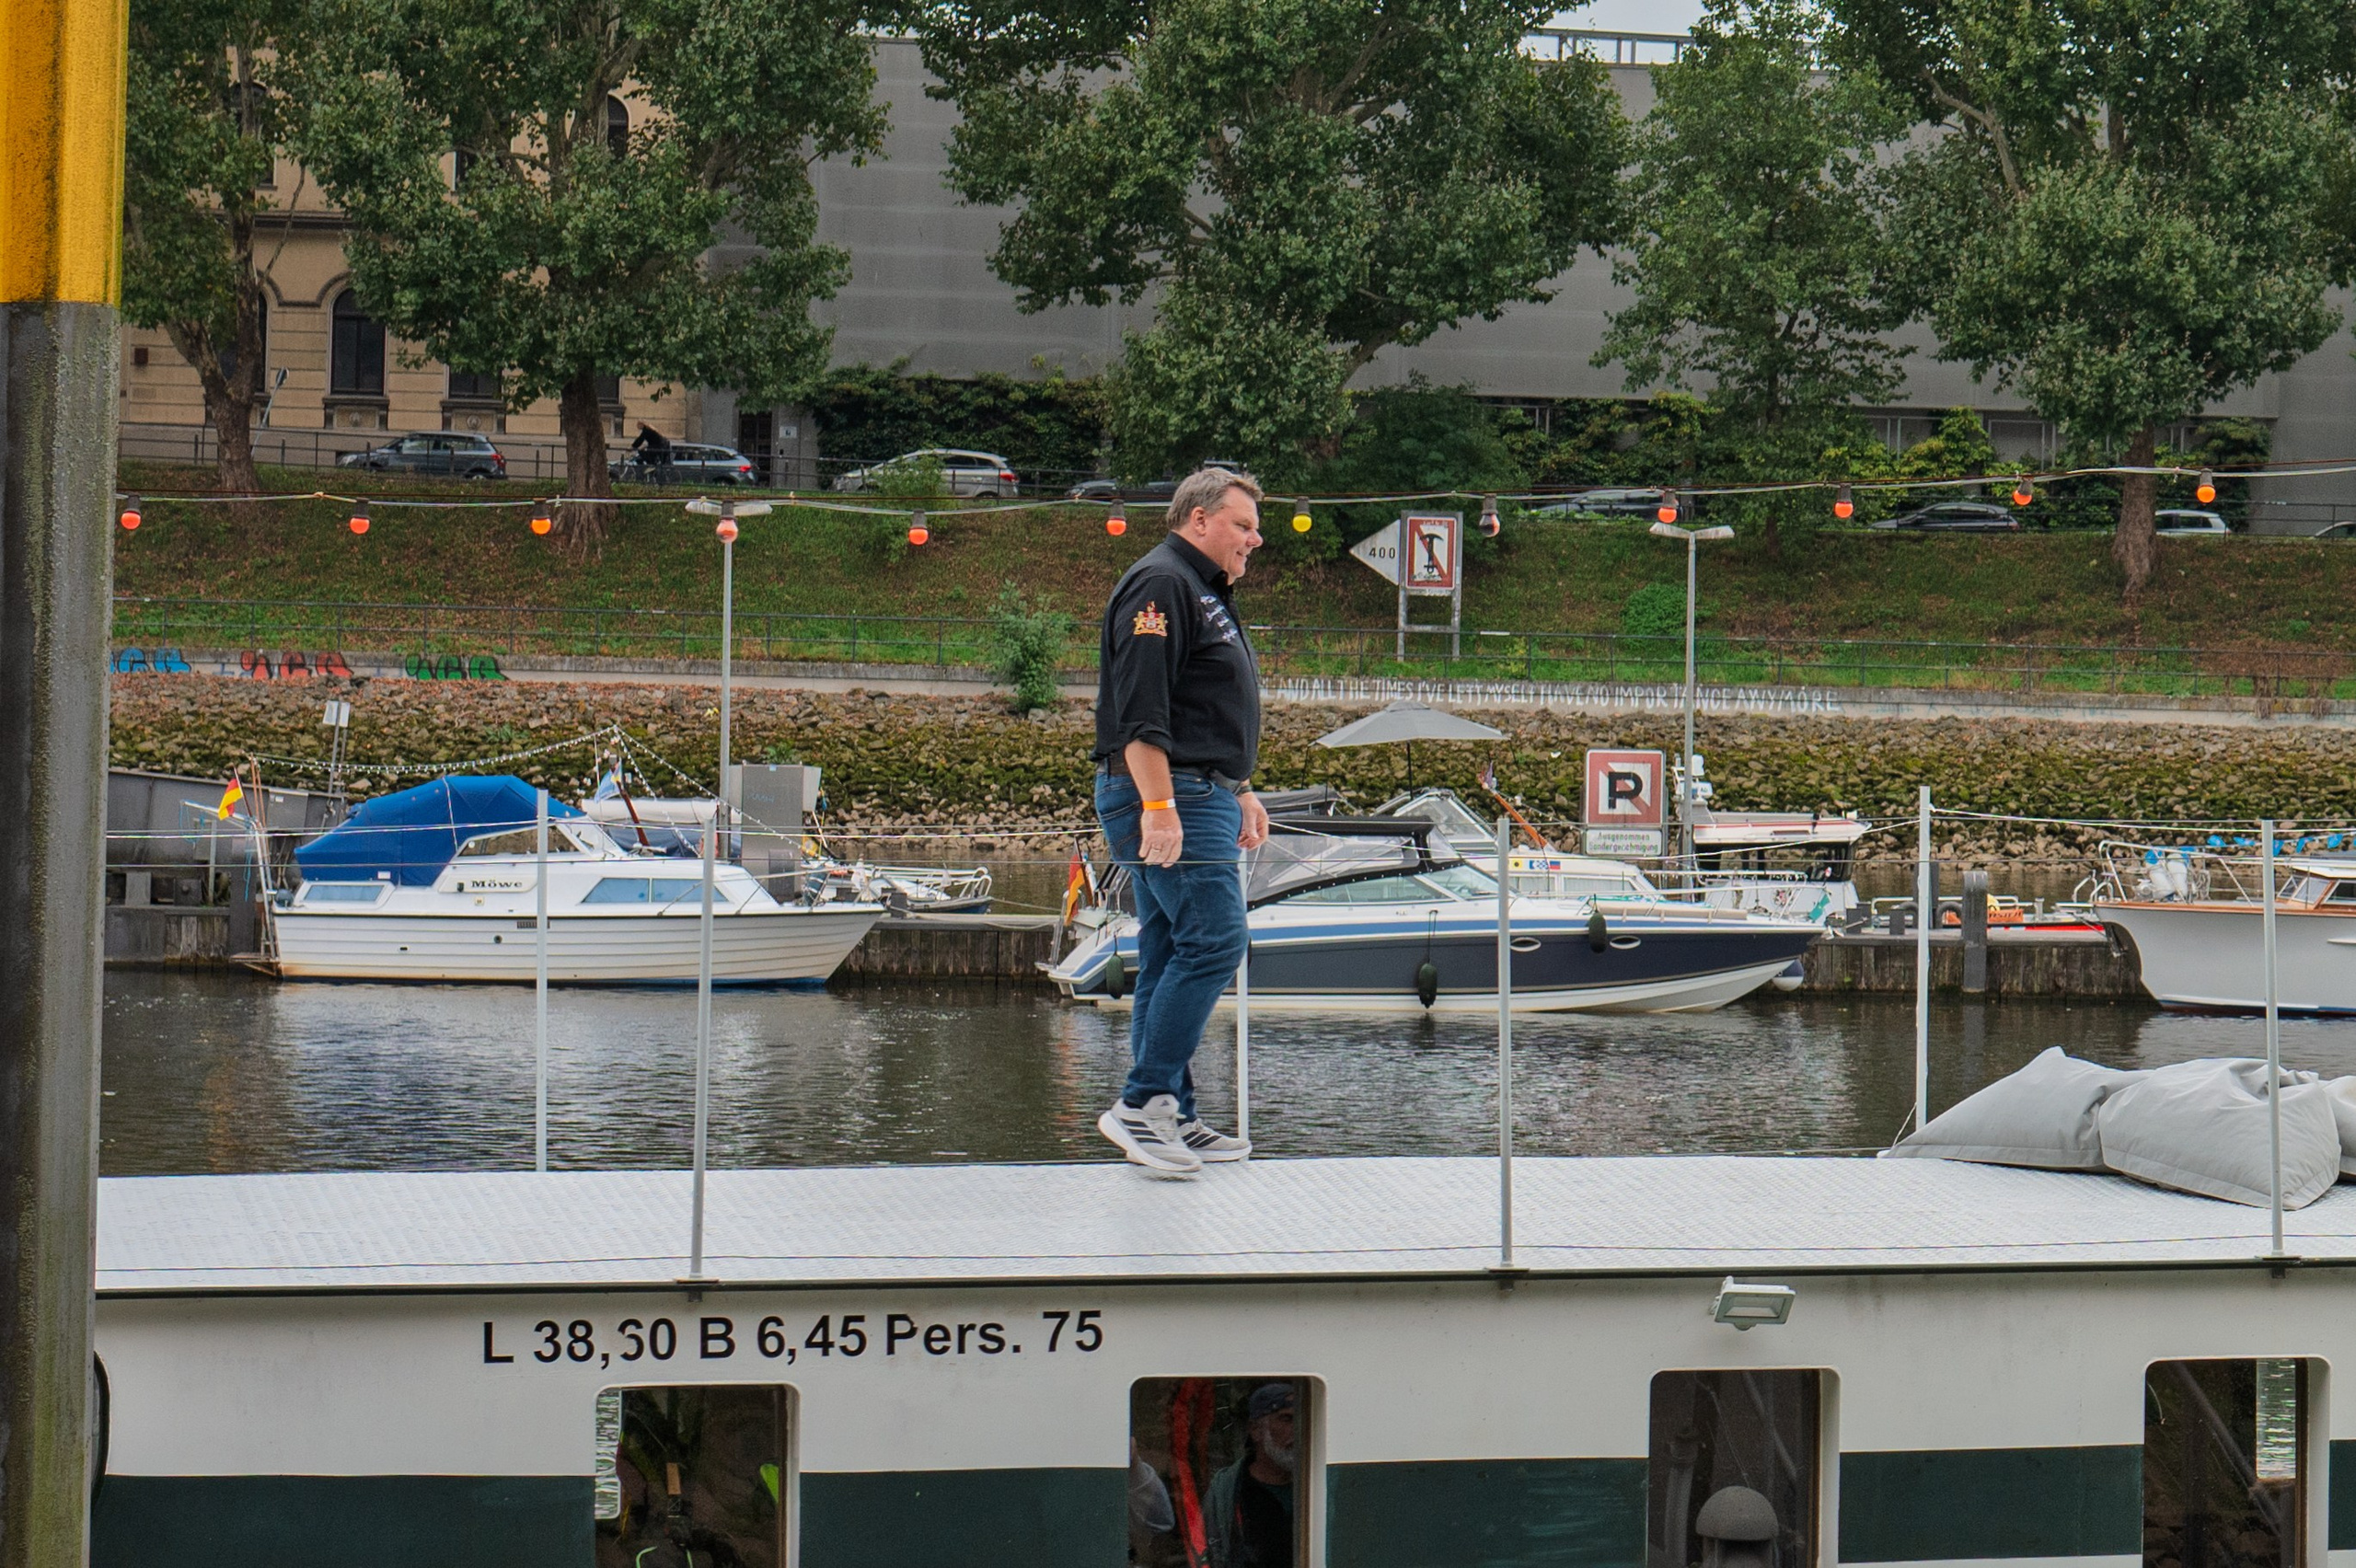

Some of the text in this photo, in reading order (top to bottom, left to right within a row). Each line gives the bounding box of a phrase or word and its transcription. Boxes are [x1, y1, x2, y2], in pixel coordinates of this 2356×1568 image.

[1369, 547, 1396, 559] 400
[1276, 677, 1310, 701] AND
[1311, 678, 1337, 700] ALL
[1337, 678, 1370, 700] THE
[1372, 679, 1414, 701] TIMES
[1540, 683, 1585, 707] HAVE
[1585, 685, 1610, 707] NO
[1735, 686, 1842, 712] ANYMORE
[1609, 772, 1643, 809] P
[1597, 832, 1650, 842] Ausgenommen
[472, 880, 523, 888] Möwe
[483, 1320, 514, 1364] L
[699, 1317, 735, 1359] B
[756, 1314, 868, 1364] 6,45
[887, 1312, 1022, 1356] Pers.
[1041, 1309, 1103, 1353] 75
